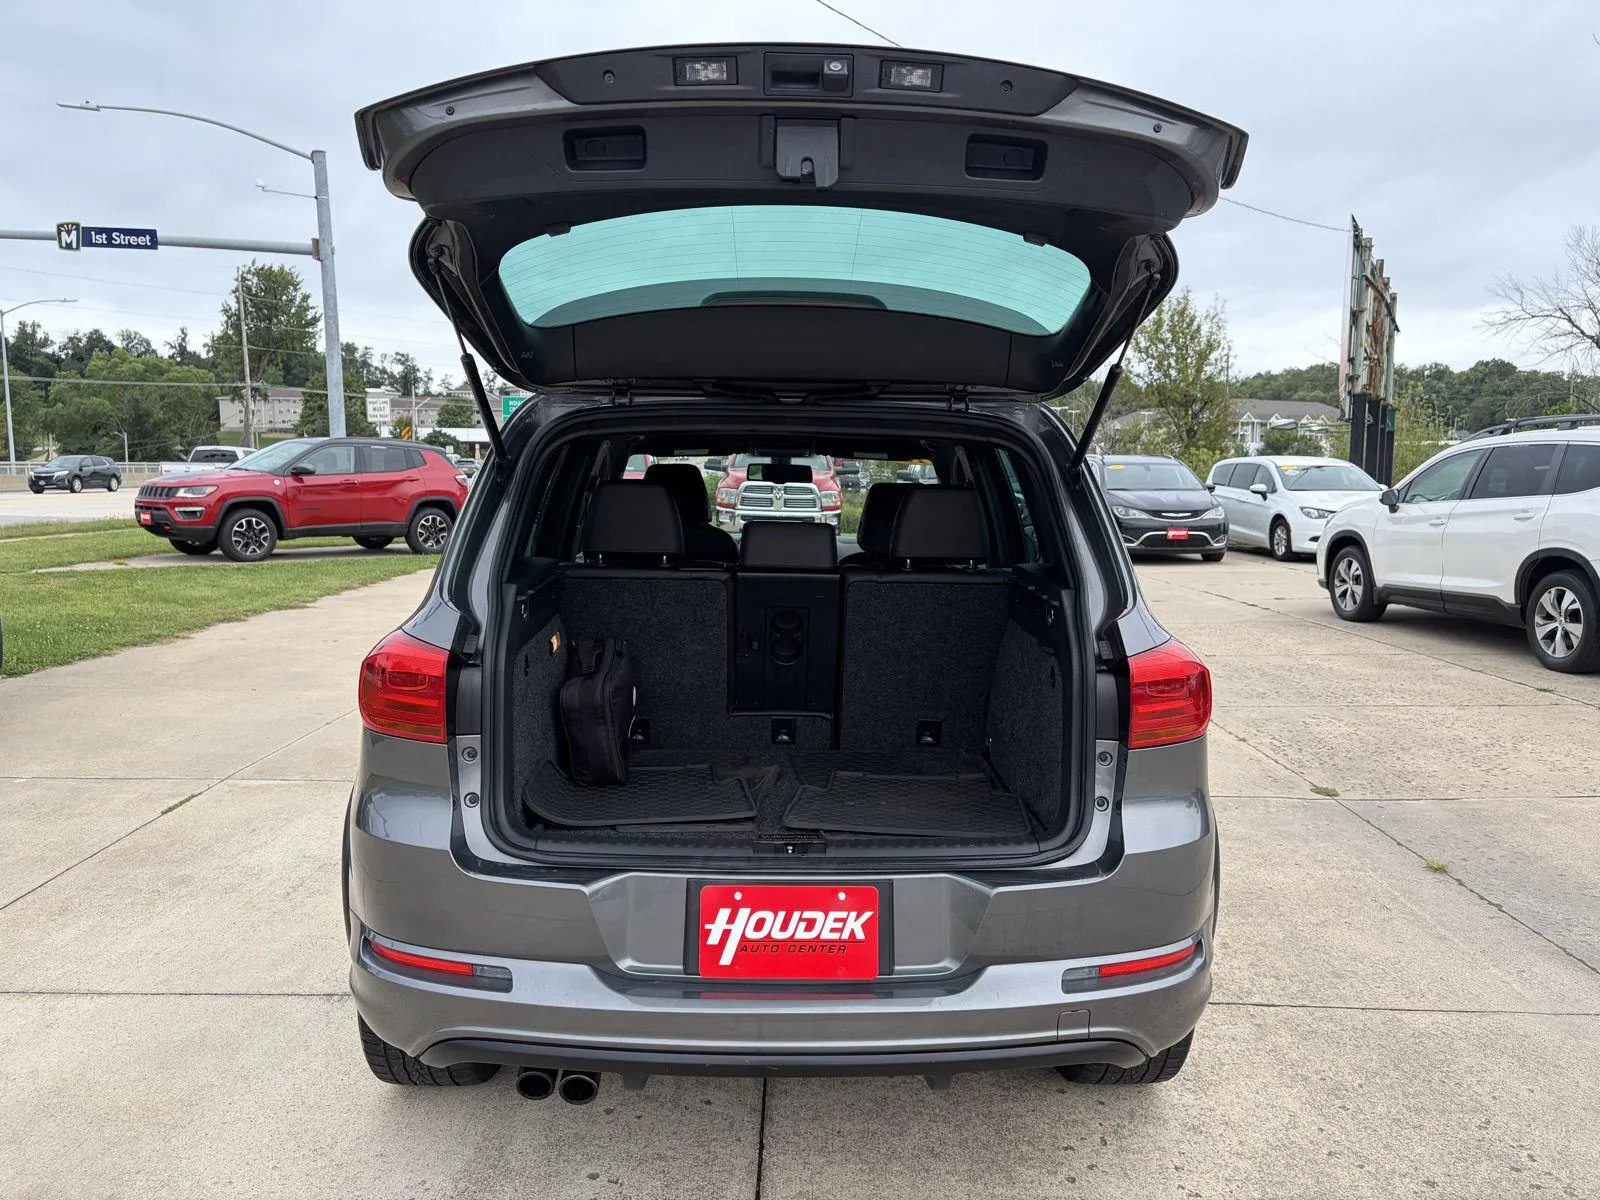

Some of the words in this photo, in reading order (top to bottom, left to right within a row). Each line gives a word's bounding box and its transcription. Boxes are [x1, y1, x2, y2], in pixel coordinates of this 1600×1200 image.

[91, 231, 107, 244] 1st
[111, 232, 151, 246] Street
[704, 907, 874, 966] HOUDEK
[739, 944, 780, 954] AUTO
[787, 944, 847, 954] CENTER
